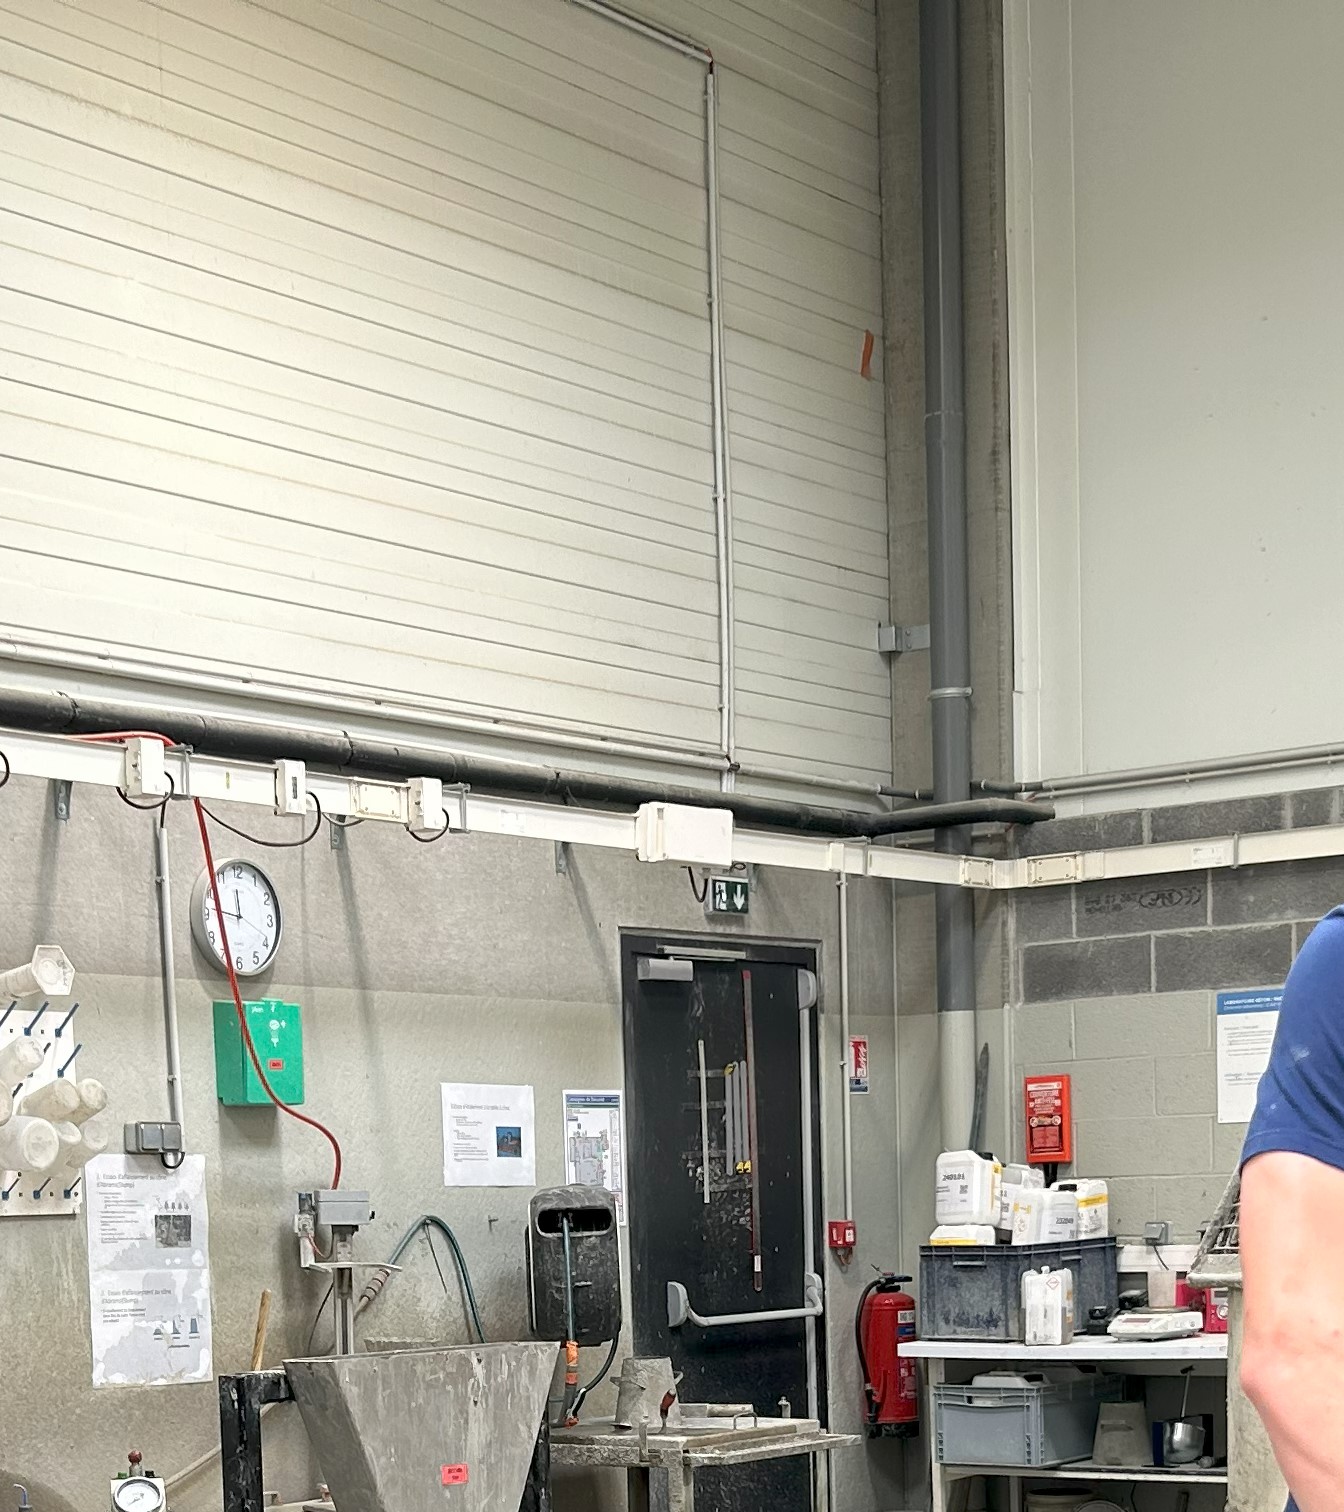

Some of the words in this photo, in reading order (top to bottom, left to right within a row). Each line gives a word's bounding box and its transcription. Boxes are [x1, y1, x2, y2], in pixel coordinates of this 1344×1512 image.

[217, 871, 225, 884] 11
[232, 865, 243, 879] 12
[252, 874, 257, 887] 1
[264, 892, 270, 905] 2
[266, 914, 274, 928] 3
[262, 935, 270, 950] 4
[236, 956, 244, 970] 6
[253, 951, 260, 965] 5
